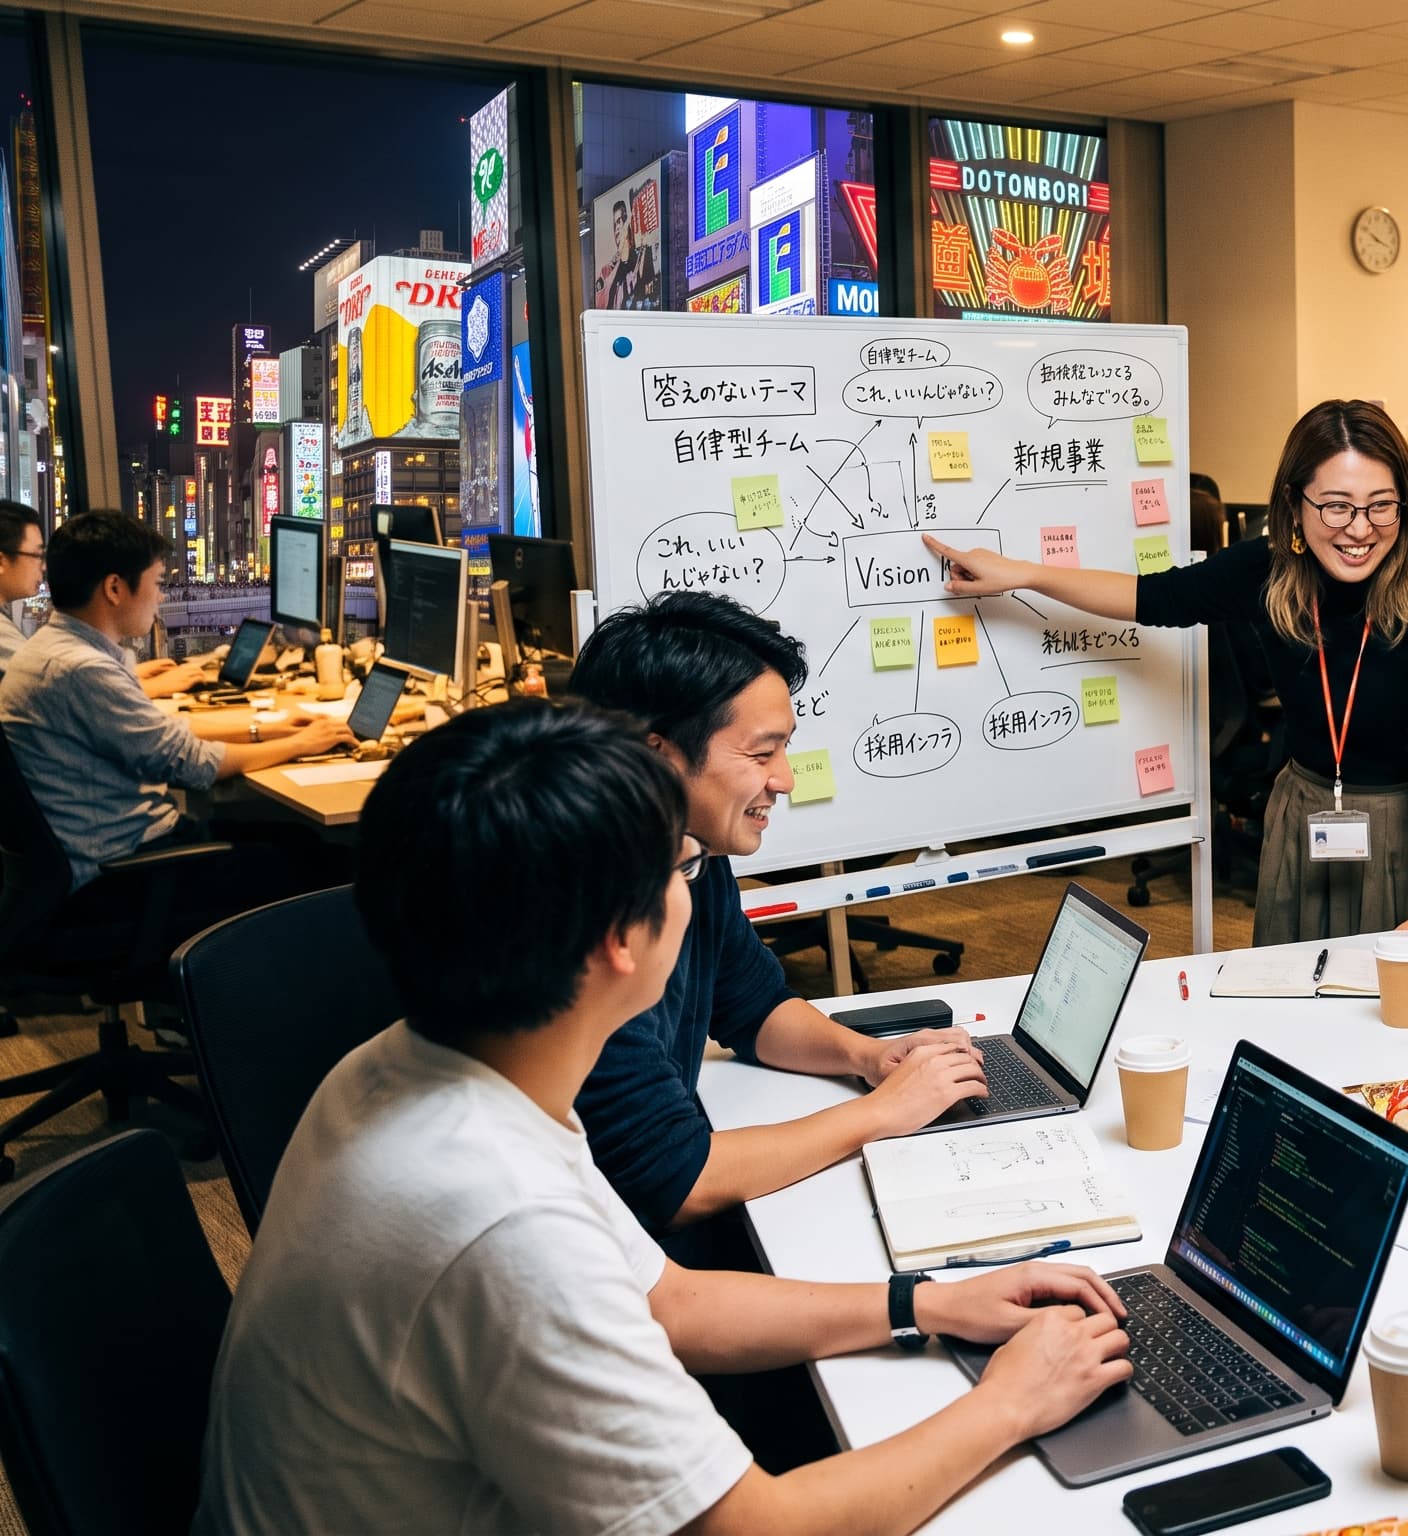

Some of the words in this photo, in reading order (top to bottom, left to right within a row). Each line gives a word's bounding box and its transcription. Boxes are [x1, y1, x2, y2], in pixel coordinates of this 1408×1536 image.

[962, 166, 1088, 207] DOTONBORI
[404, 281, 466, 311] DR
[653, 373, 807, 407] 答えのないテーマ
[674, 427, 810, 464] 自律型チーム
[1013, 438, 1106, 476] 新規事業
[855, 556, 931, 590] Vision
[988, 704, 1073, 740] 採用インフラ
[864, 727, 952, 763] 採用インフラ
